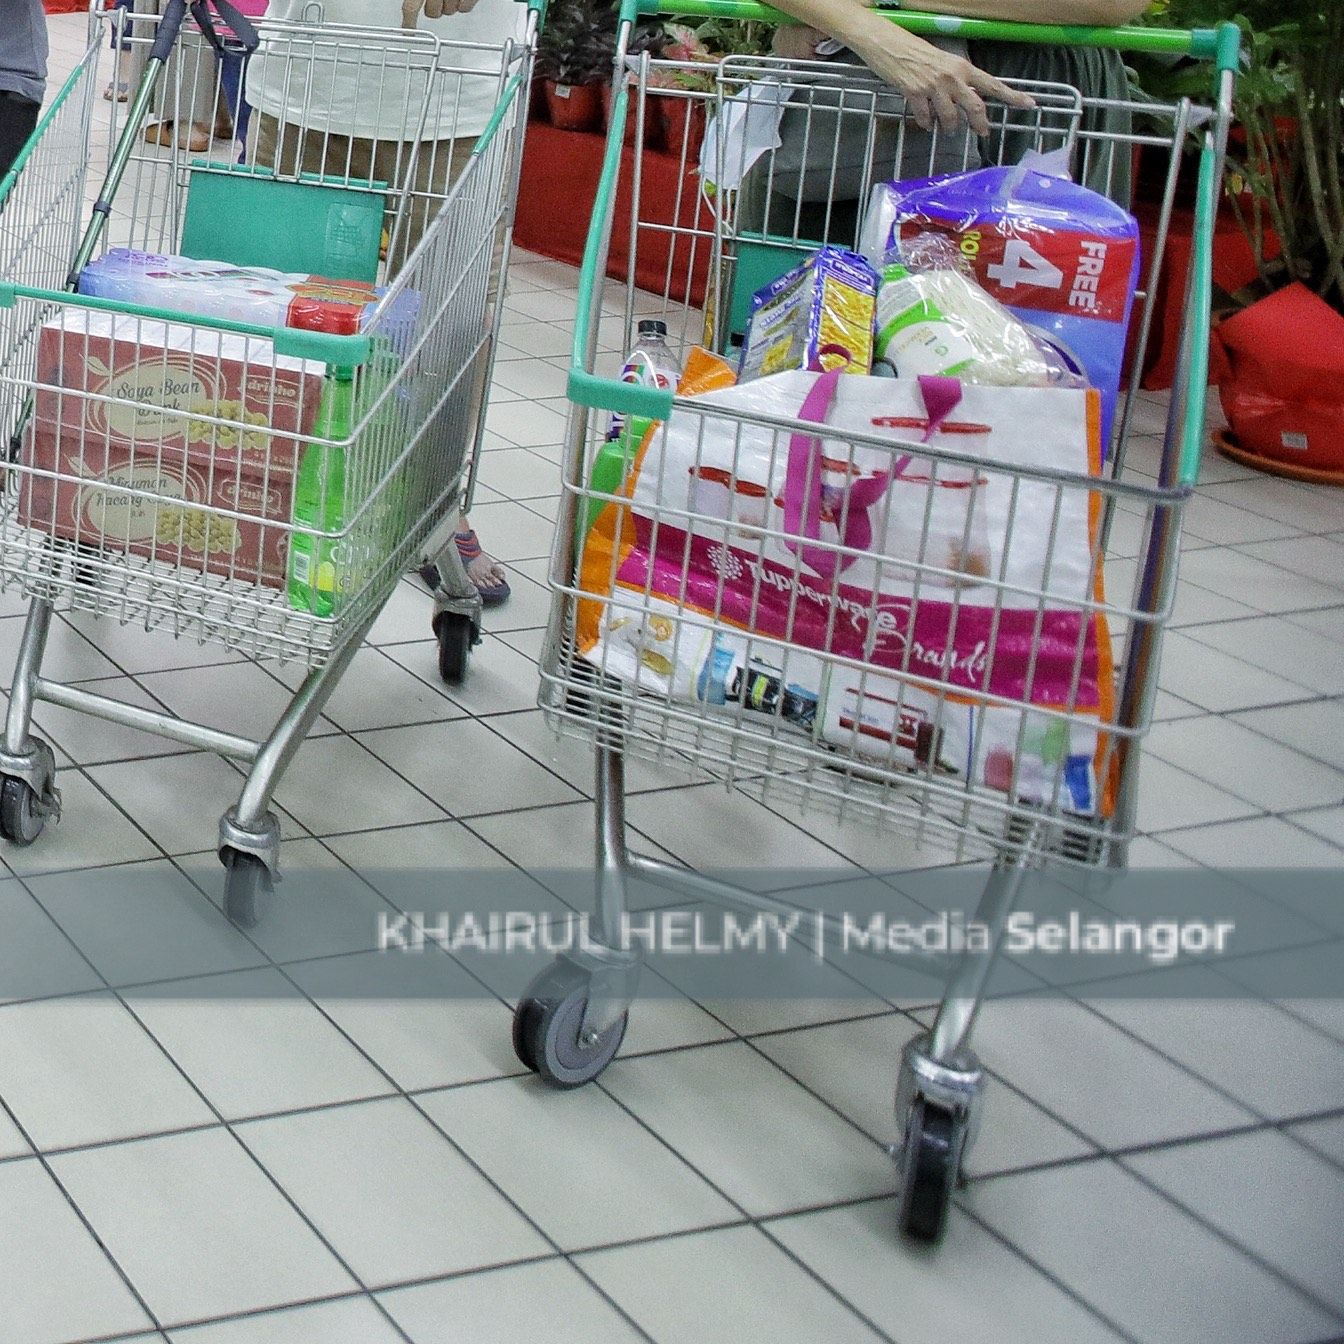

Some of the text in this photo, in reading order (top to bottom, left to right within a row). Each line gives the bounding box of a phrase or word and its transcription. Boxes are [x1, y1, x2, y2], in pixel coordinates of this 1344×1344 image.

[986, 239, 1064, 289] 4
[1068, 240, 1108, 310] FREE
[117, 380, 200, 404] Soya Bean
[248, 379, 296, 399] drinho
[744, 558, 897, 633] Tupperware
[863, 605, 987, 683] Brands
